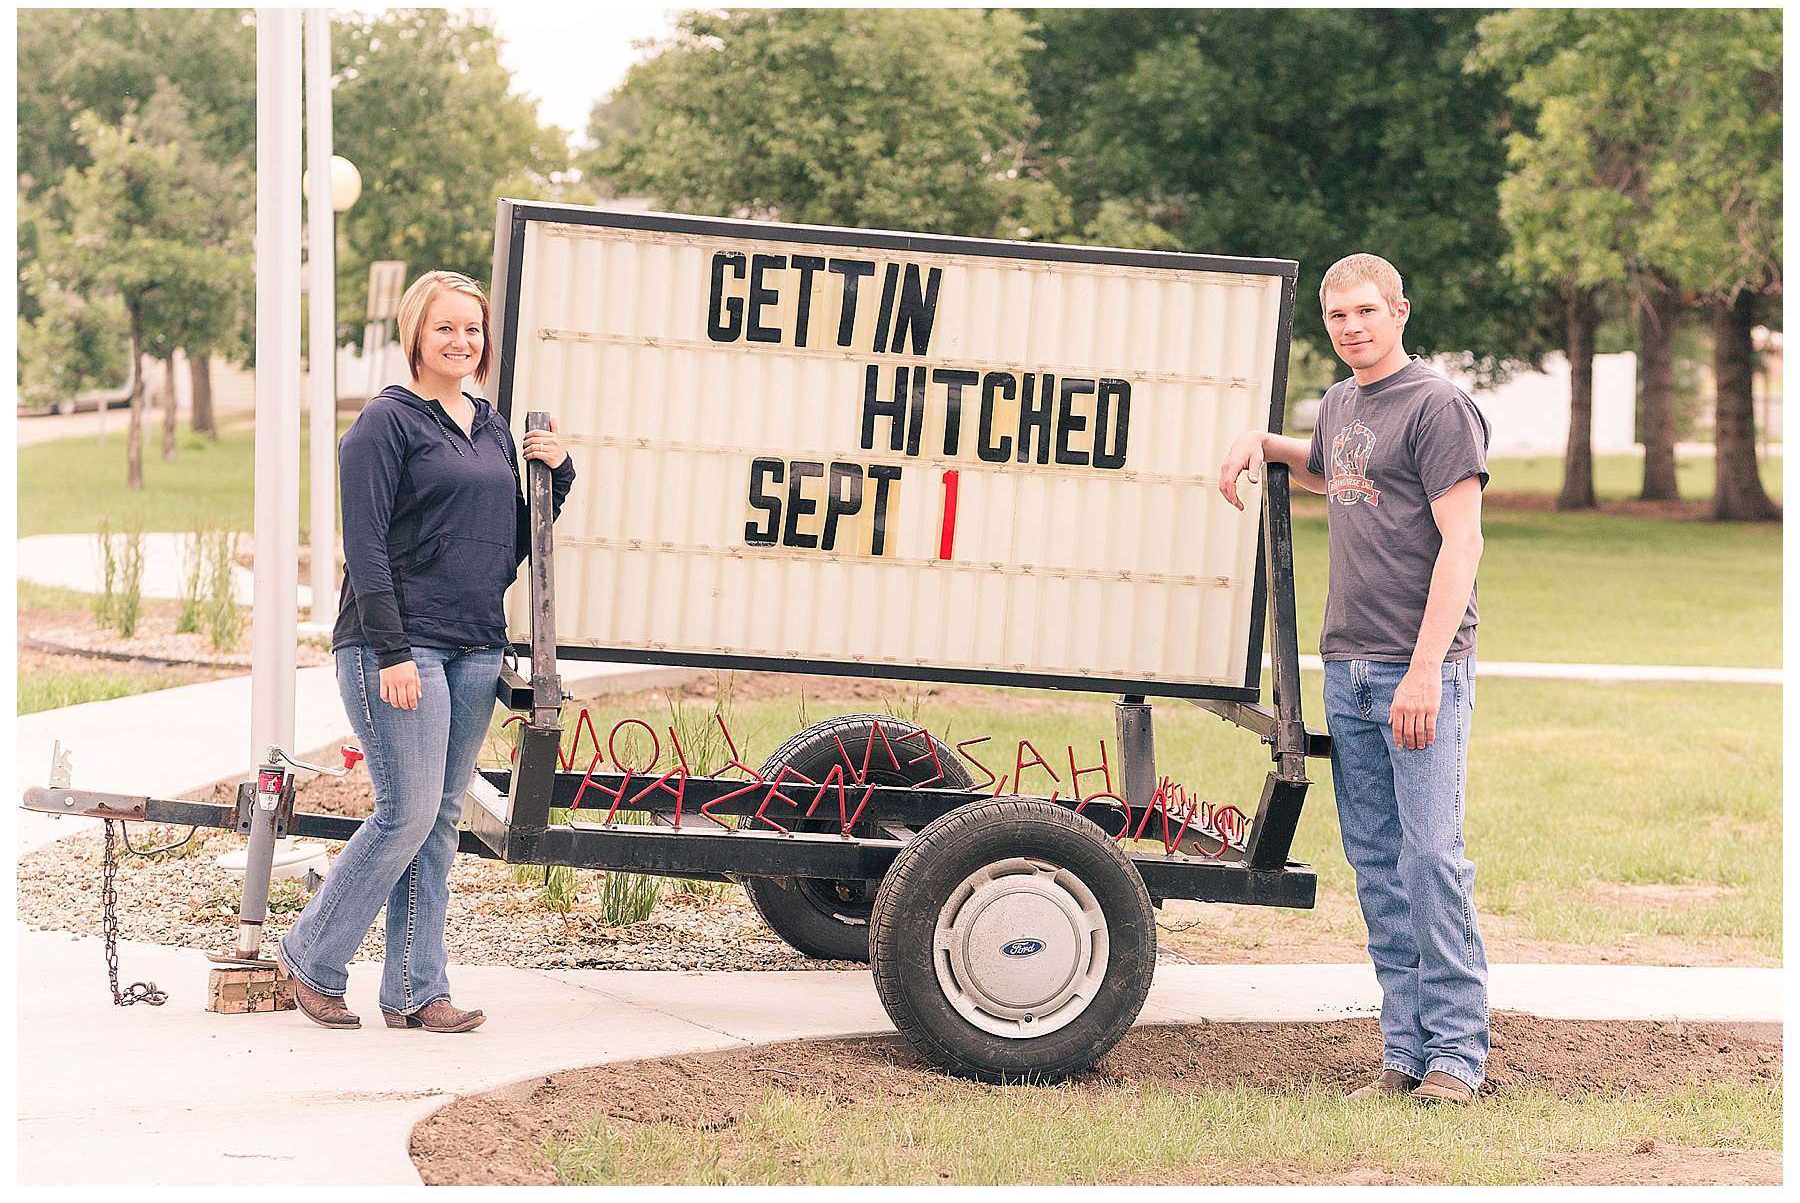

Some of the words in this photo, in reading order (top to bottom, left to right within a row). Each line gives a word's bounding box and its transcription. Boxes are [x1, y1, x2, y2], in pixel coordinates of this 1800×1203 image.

[706, 250, 943, 357] GETTIN
[860, 364, 1132, 470] HITCHED
[744, 456, 902, 556] SEPT
[939, 469, 959, 560] 1
[570, 751, 876, 839] HAZEN
[1009, 941, 1037, 955] Ford
